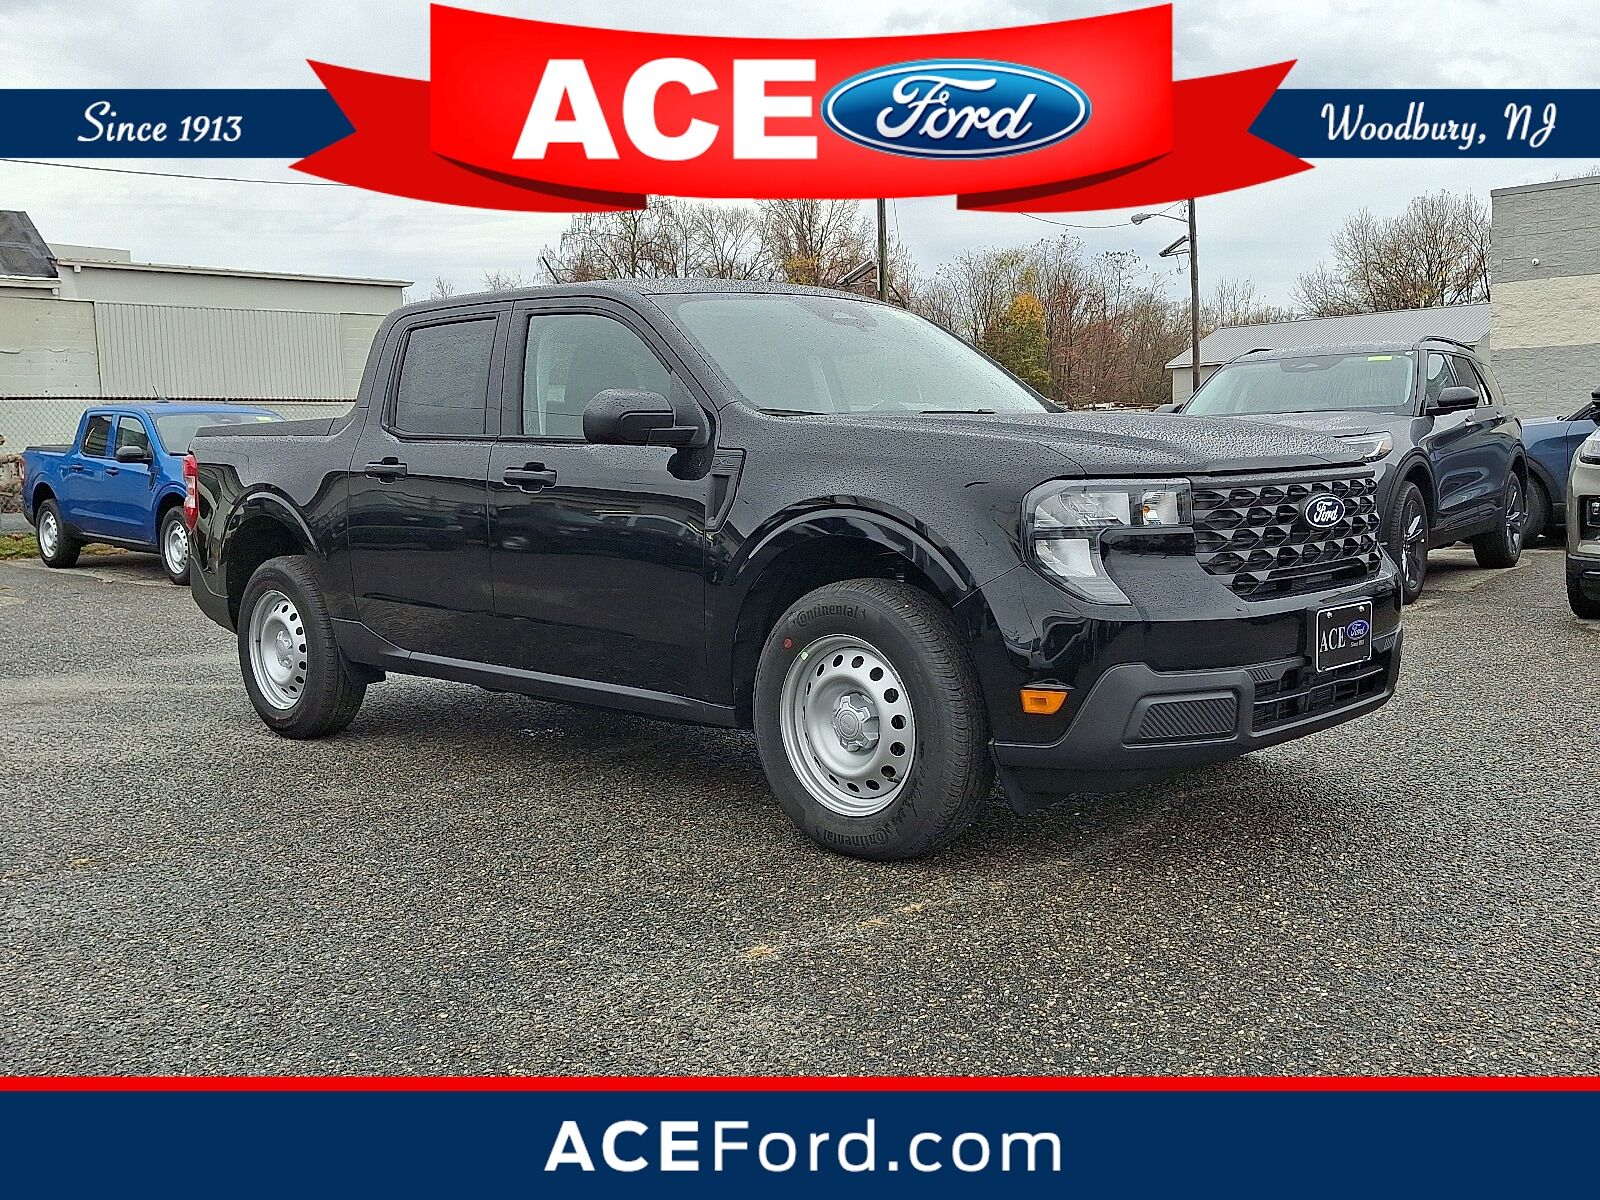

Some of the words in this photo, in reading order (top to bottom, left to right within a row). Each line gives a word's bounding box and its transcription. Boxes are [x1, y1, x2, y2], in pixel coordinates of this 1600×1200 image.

[1313, 500, 1339, 523] Ford
[796, 603, 859, 627] Continental
[1319, 626, 1346, 653] ACE
[1350, 623, 1366, 637] Ford
